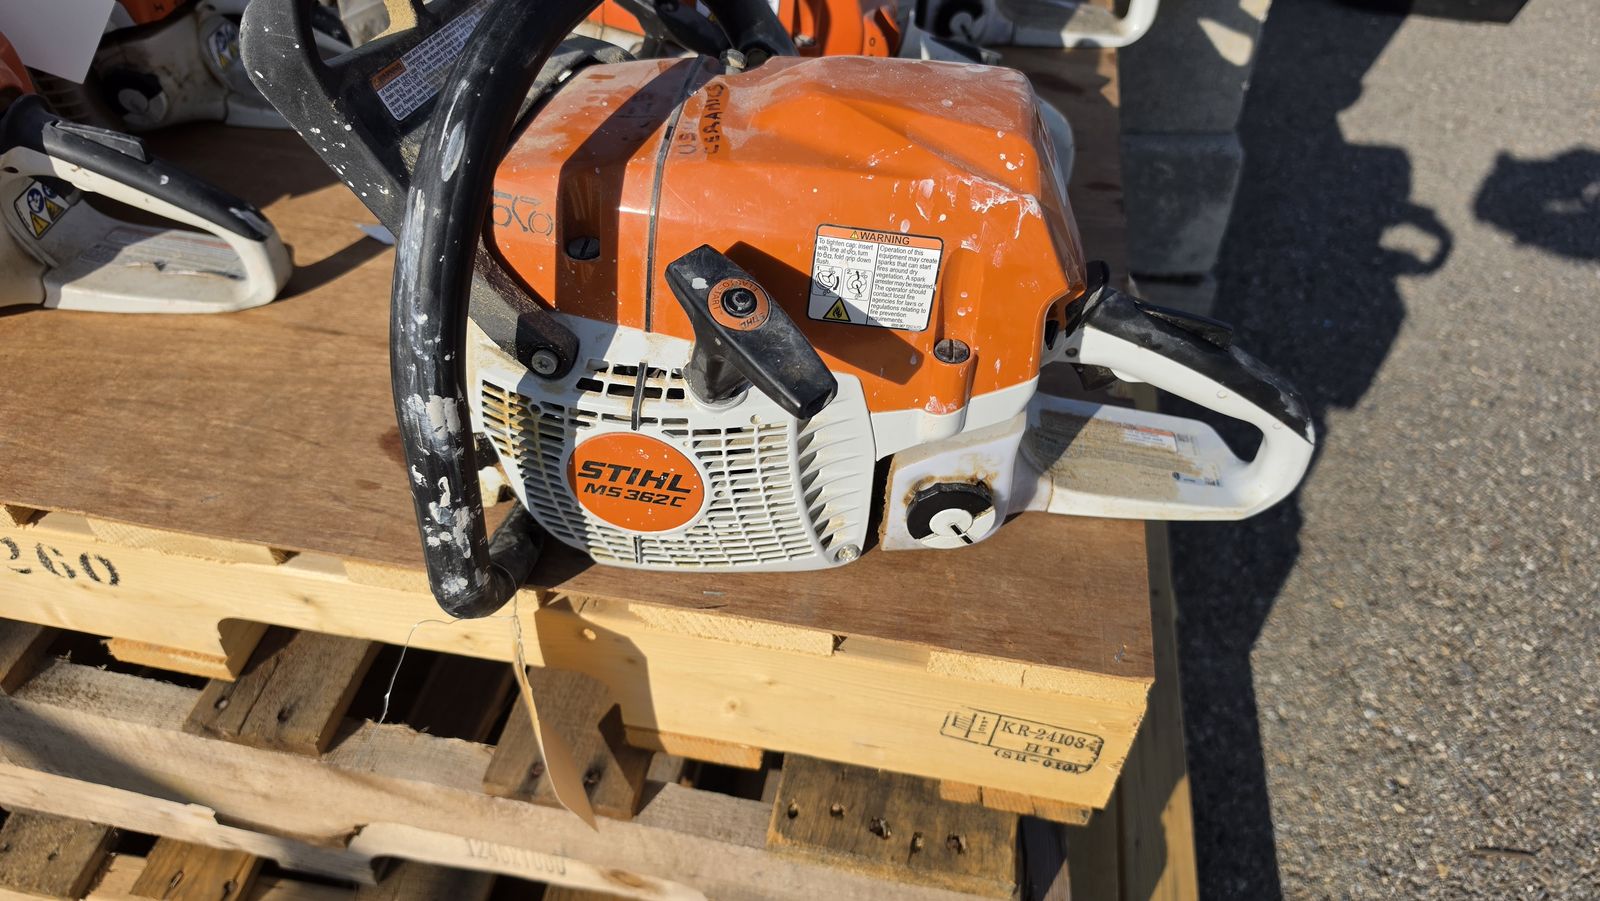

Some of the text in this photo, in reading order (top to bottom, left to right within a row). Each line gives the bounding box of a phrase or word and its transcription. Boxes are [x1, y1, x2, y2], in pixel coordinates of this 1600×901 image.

[860, 231, 910, 246] WARNING
[826, 239, 845, 248] tighten
[880, 244, 907, 254] Operation
[845, 254, 856, 262] grip
[878, 252, 908, 261] equipment
[920, 257, 938, 265] create
[877, 259, 896, 267] sparks
[875, 272, 905, 280] vegetation.
[909, 268, 919, 276] dry
[885, 285, 909, 293] operator
[908, 287, 927, 295] should
[871, 296, 896, 304] agencies
[871, 303, 900, 312] regulations
[900, 306, 921, 314] relating
[878, 310, 908, 318] prevention
[577, 460, 691, 494] STIHL
[1024, 742, 1061, 757] HT
